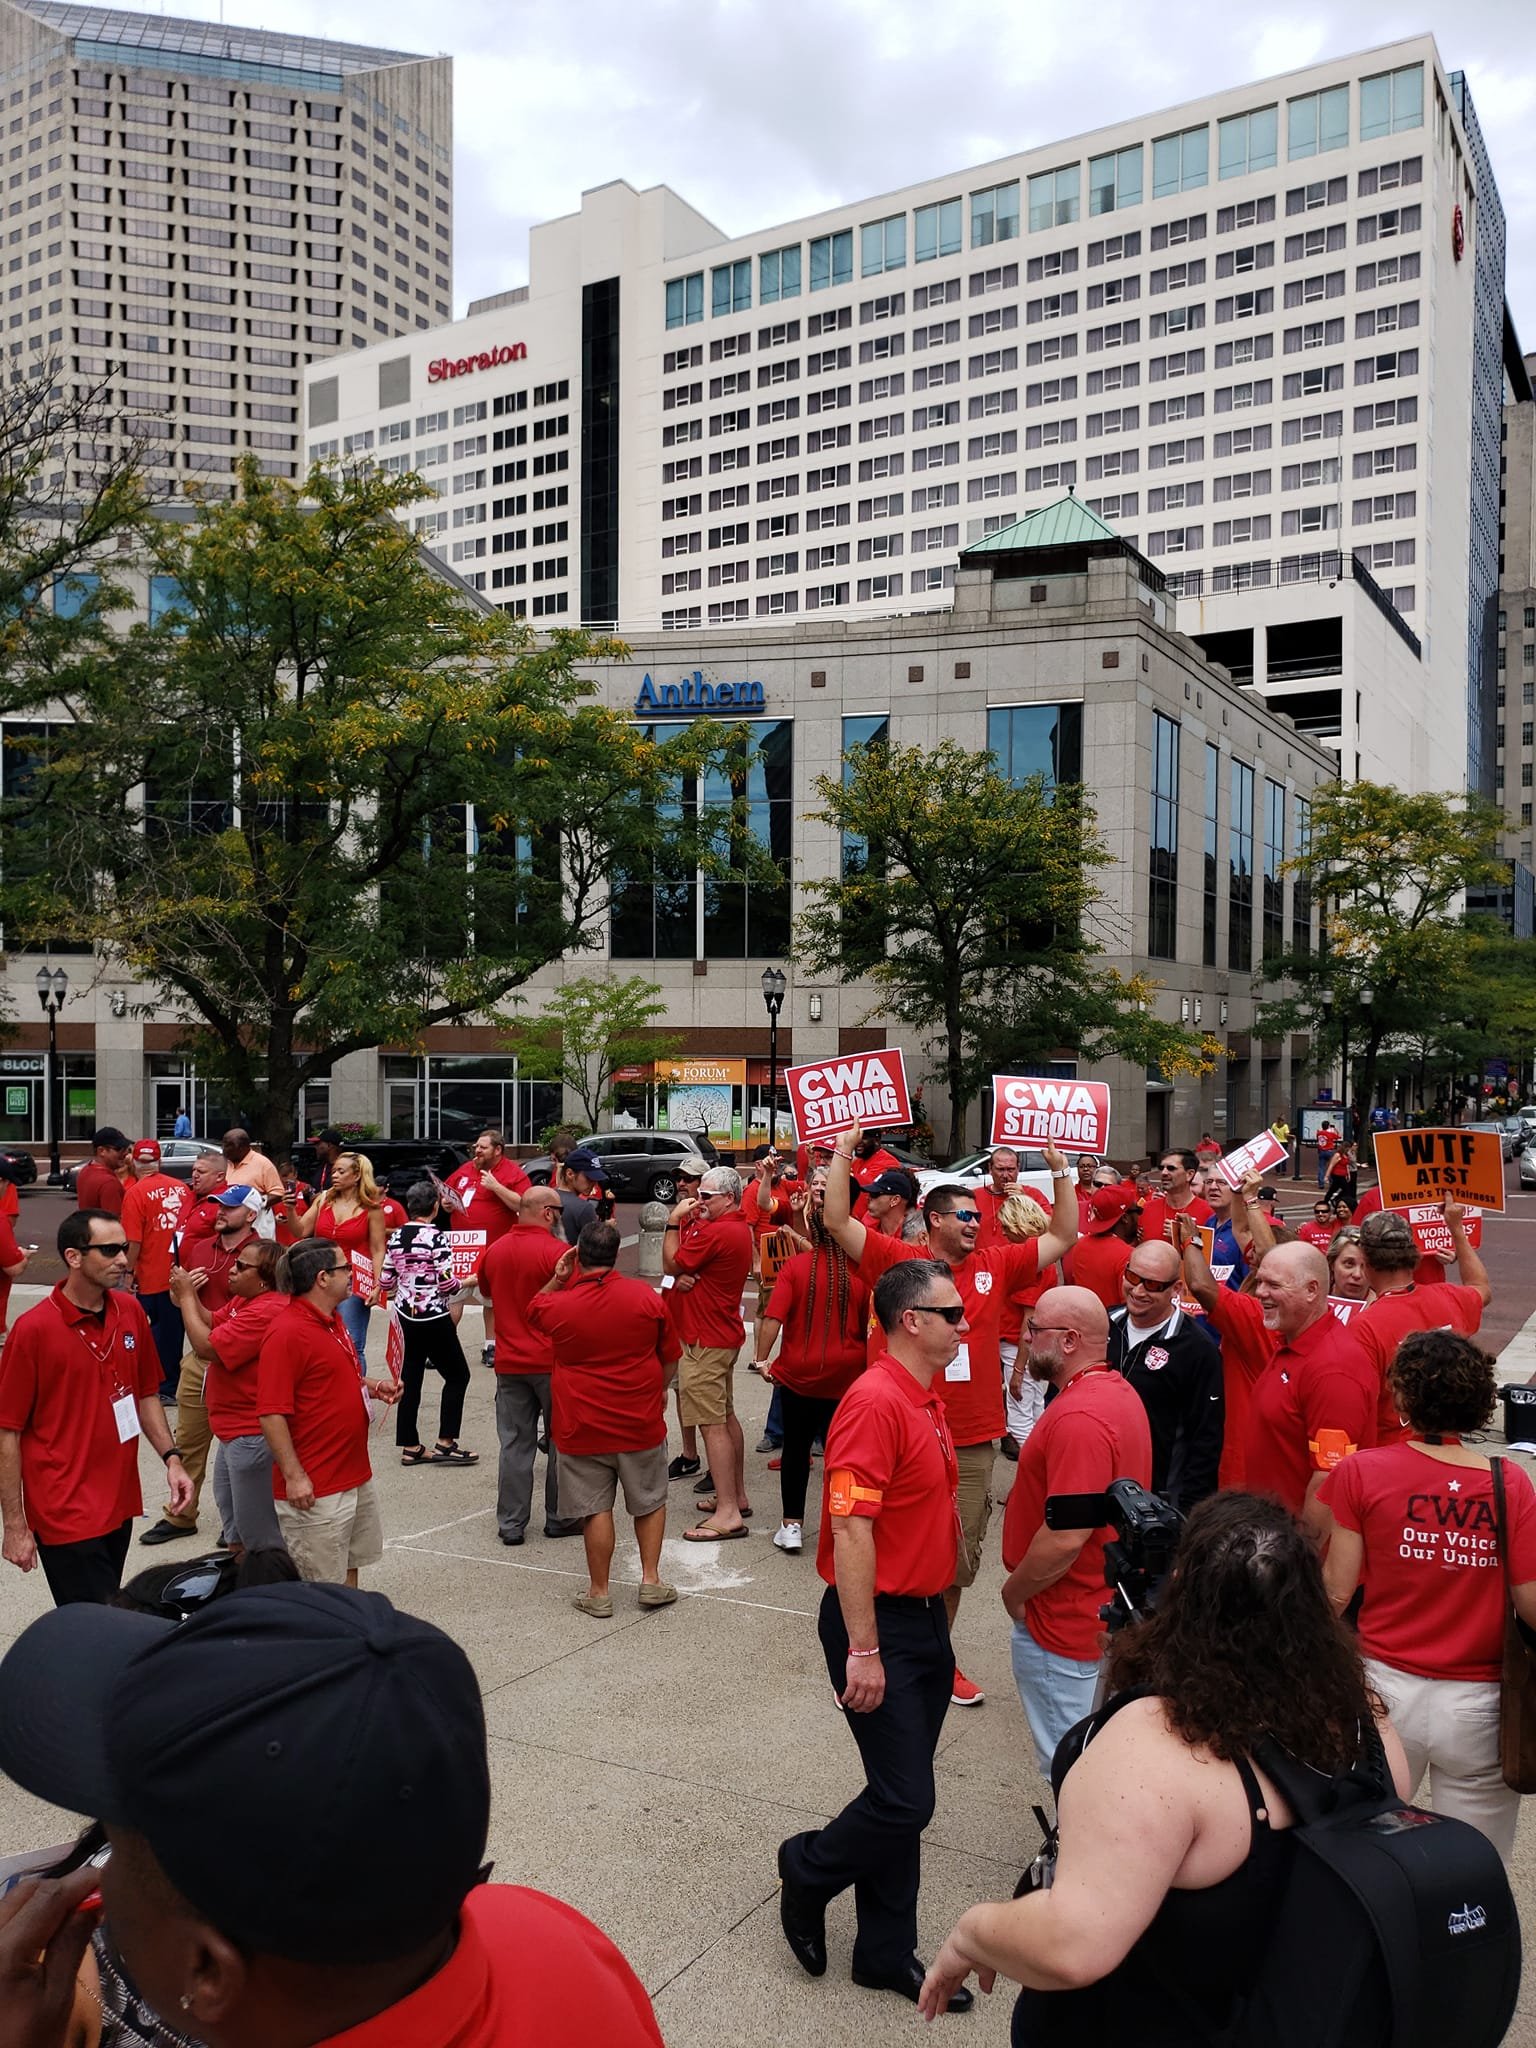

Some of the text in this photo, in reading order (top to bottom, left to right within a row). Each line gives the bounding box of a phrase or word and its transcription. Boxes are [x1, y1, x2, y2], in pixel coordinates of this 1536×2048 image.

[428, 342, 527, 383] Sheraton
[634, 671, 766, 707] Anthem
[799, 1058, 894, 1100] CWA
[804, 1086, 899, 1128] STRONG
[1004, 1082, 1097, 1114] CWA
[1004, 1107, 1098, 1142] STRONG
[1400, 1134, 1475, 1165] WTF
[1416, 1166, 1469, 1185] AT$T
[147, 1187, 187, 1200] WE ARE
[1390, 1189, 1433, 1202] Where's
[1456, 1188, 1496, 1203] Fairness
[463, 1232, 479, 1243] UP
[1417, 1223, 1476, 1239] WORKS'
[1407, 1494, 1498, 1531] CWA
[1403, 1527, 1497, 1550] Our Voice
[1399, 1544, 1499, 1568] Our Union
